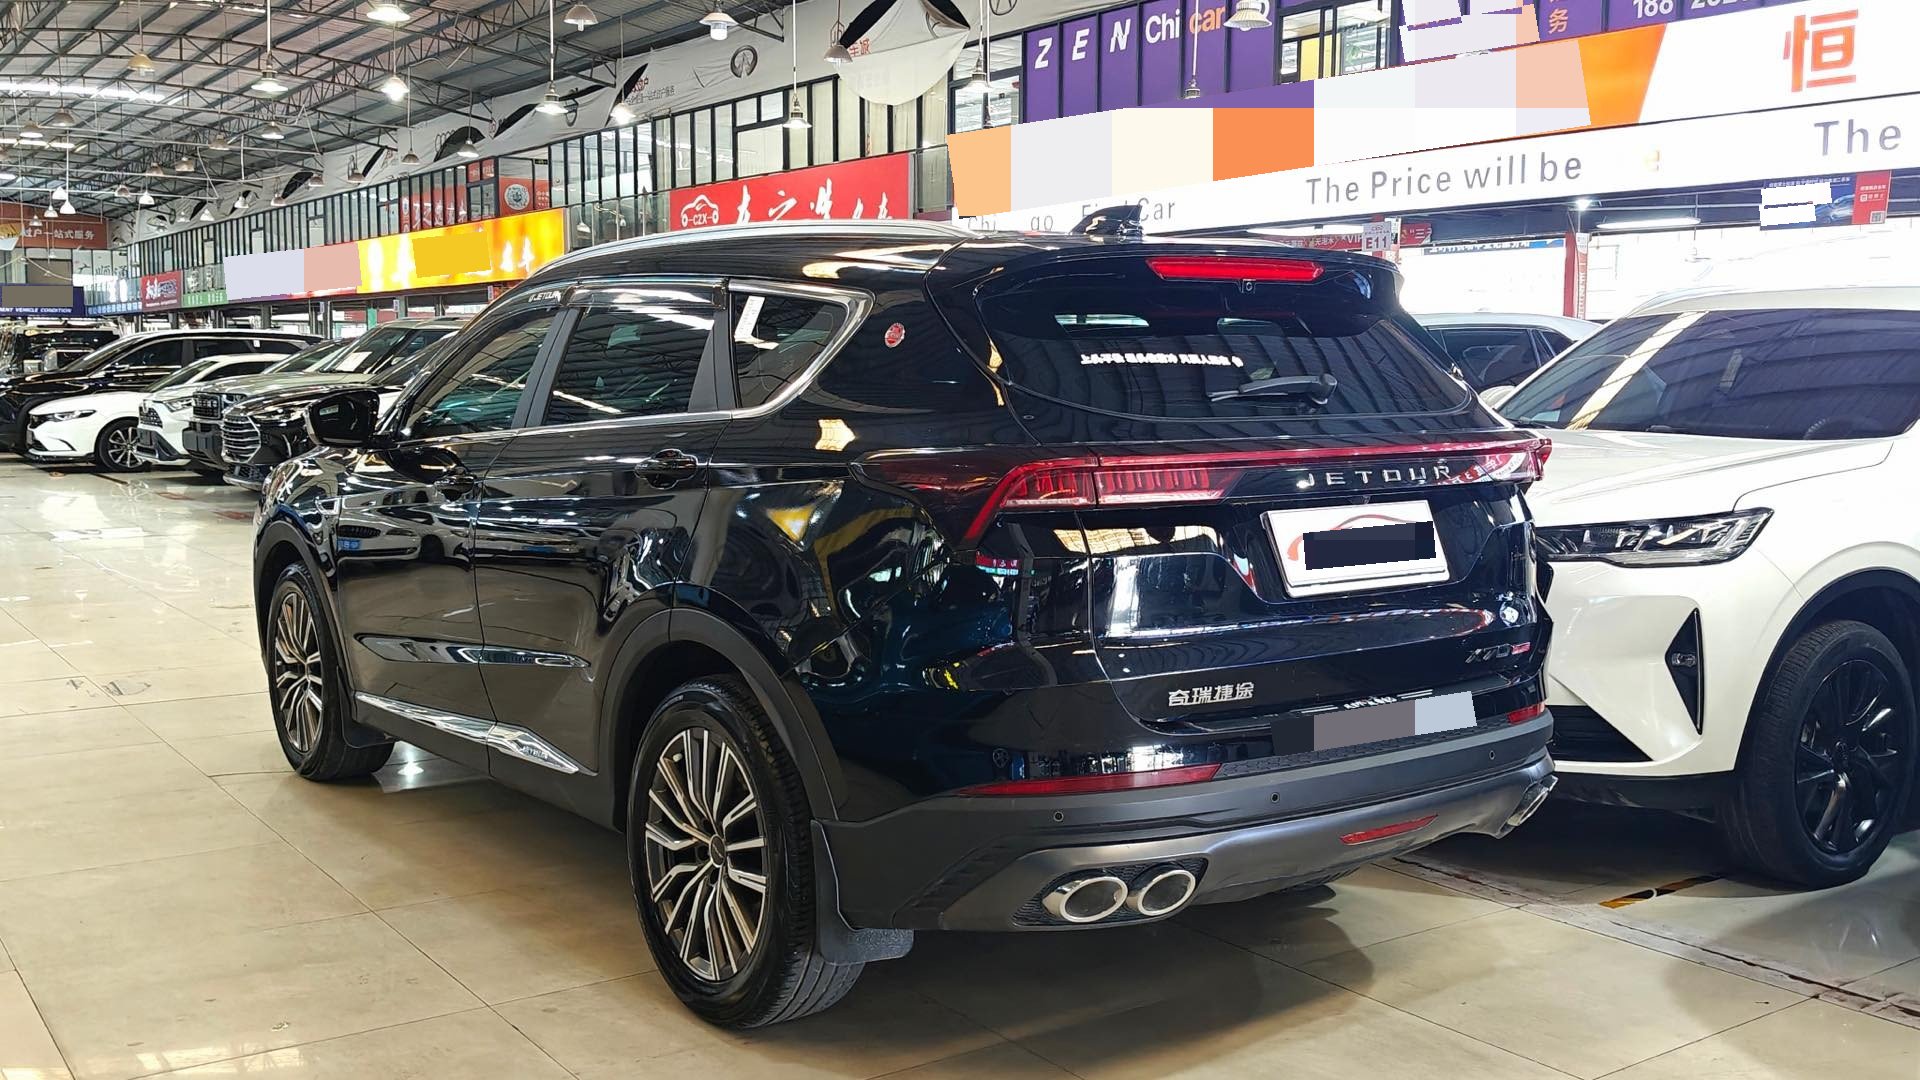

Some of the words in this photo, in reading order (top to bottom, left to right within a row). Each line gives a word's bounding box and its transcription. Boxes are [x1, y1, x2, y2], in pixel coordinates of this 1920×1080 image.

[1145, 9, 1180, 44] Chi
[1189, 6, 1226, 34] car
[1783, 9, 1859, 93] 恒
[1813, 119, 1902, 156] The
[1305, 178, 1360, 205] The
[1371, 166, 1452, 199] Price
[1463, 153, 1526, 190] will
[1540, 151, 1582, 182] be
[1366, 236, 1387, 250] E11
[1296, 465, 1450, 489] JETOUR
[1168, 682, 1254, 707] 奇瑞捷途
